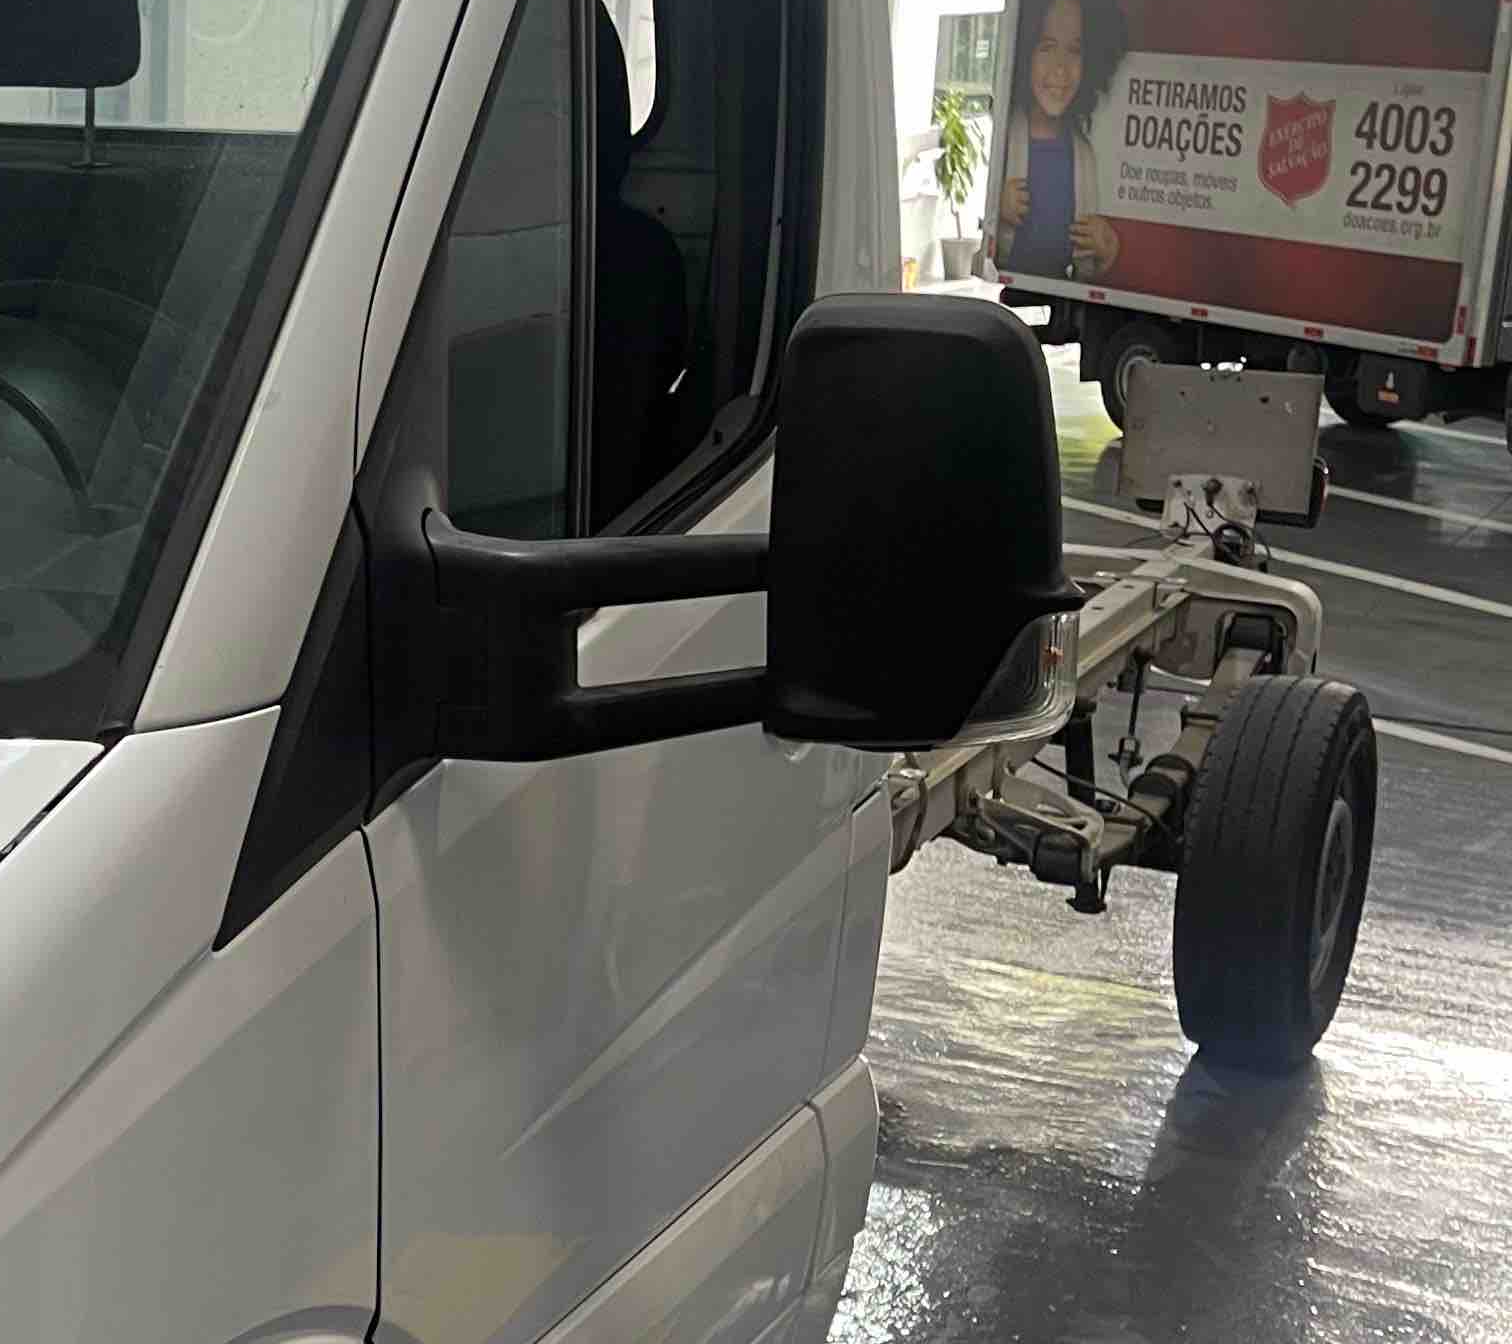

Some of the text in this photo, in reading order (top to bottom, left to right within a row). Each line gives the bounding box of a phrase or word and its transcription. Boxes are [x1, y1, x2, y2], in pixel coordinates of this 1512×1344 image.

[1128, 78, 1247, 113] RETIRAMOS
[1125, 113, 1243, 162] DOAÇÕES
[1354, 101, 1456, 156] 4003
[1120, 161, 1143, 180] Doe
[1346, 160, 1448, 217] 2299
[1118, 186, 1126, 199] e
[1128, 187, 1165, 204] outros
